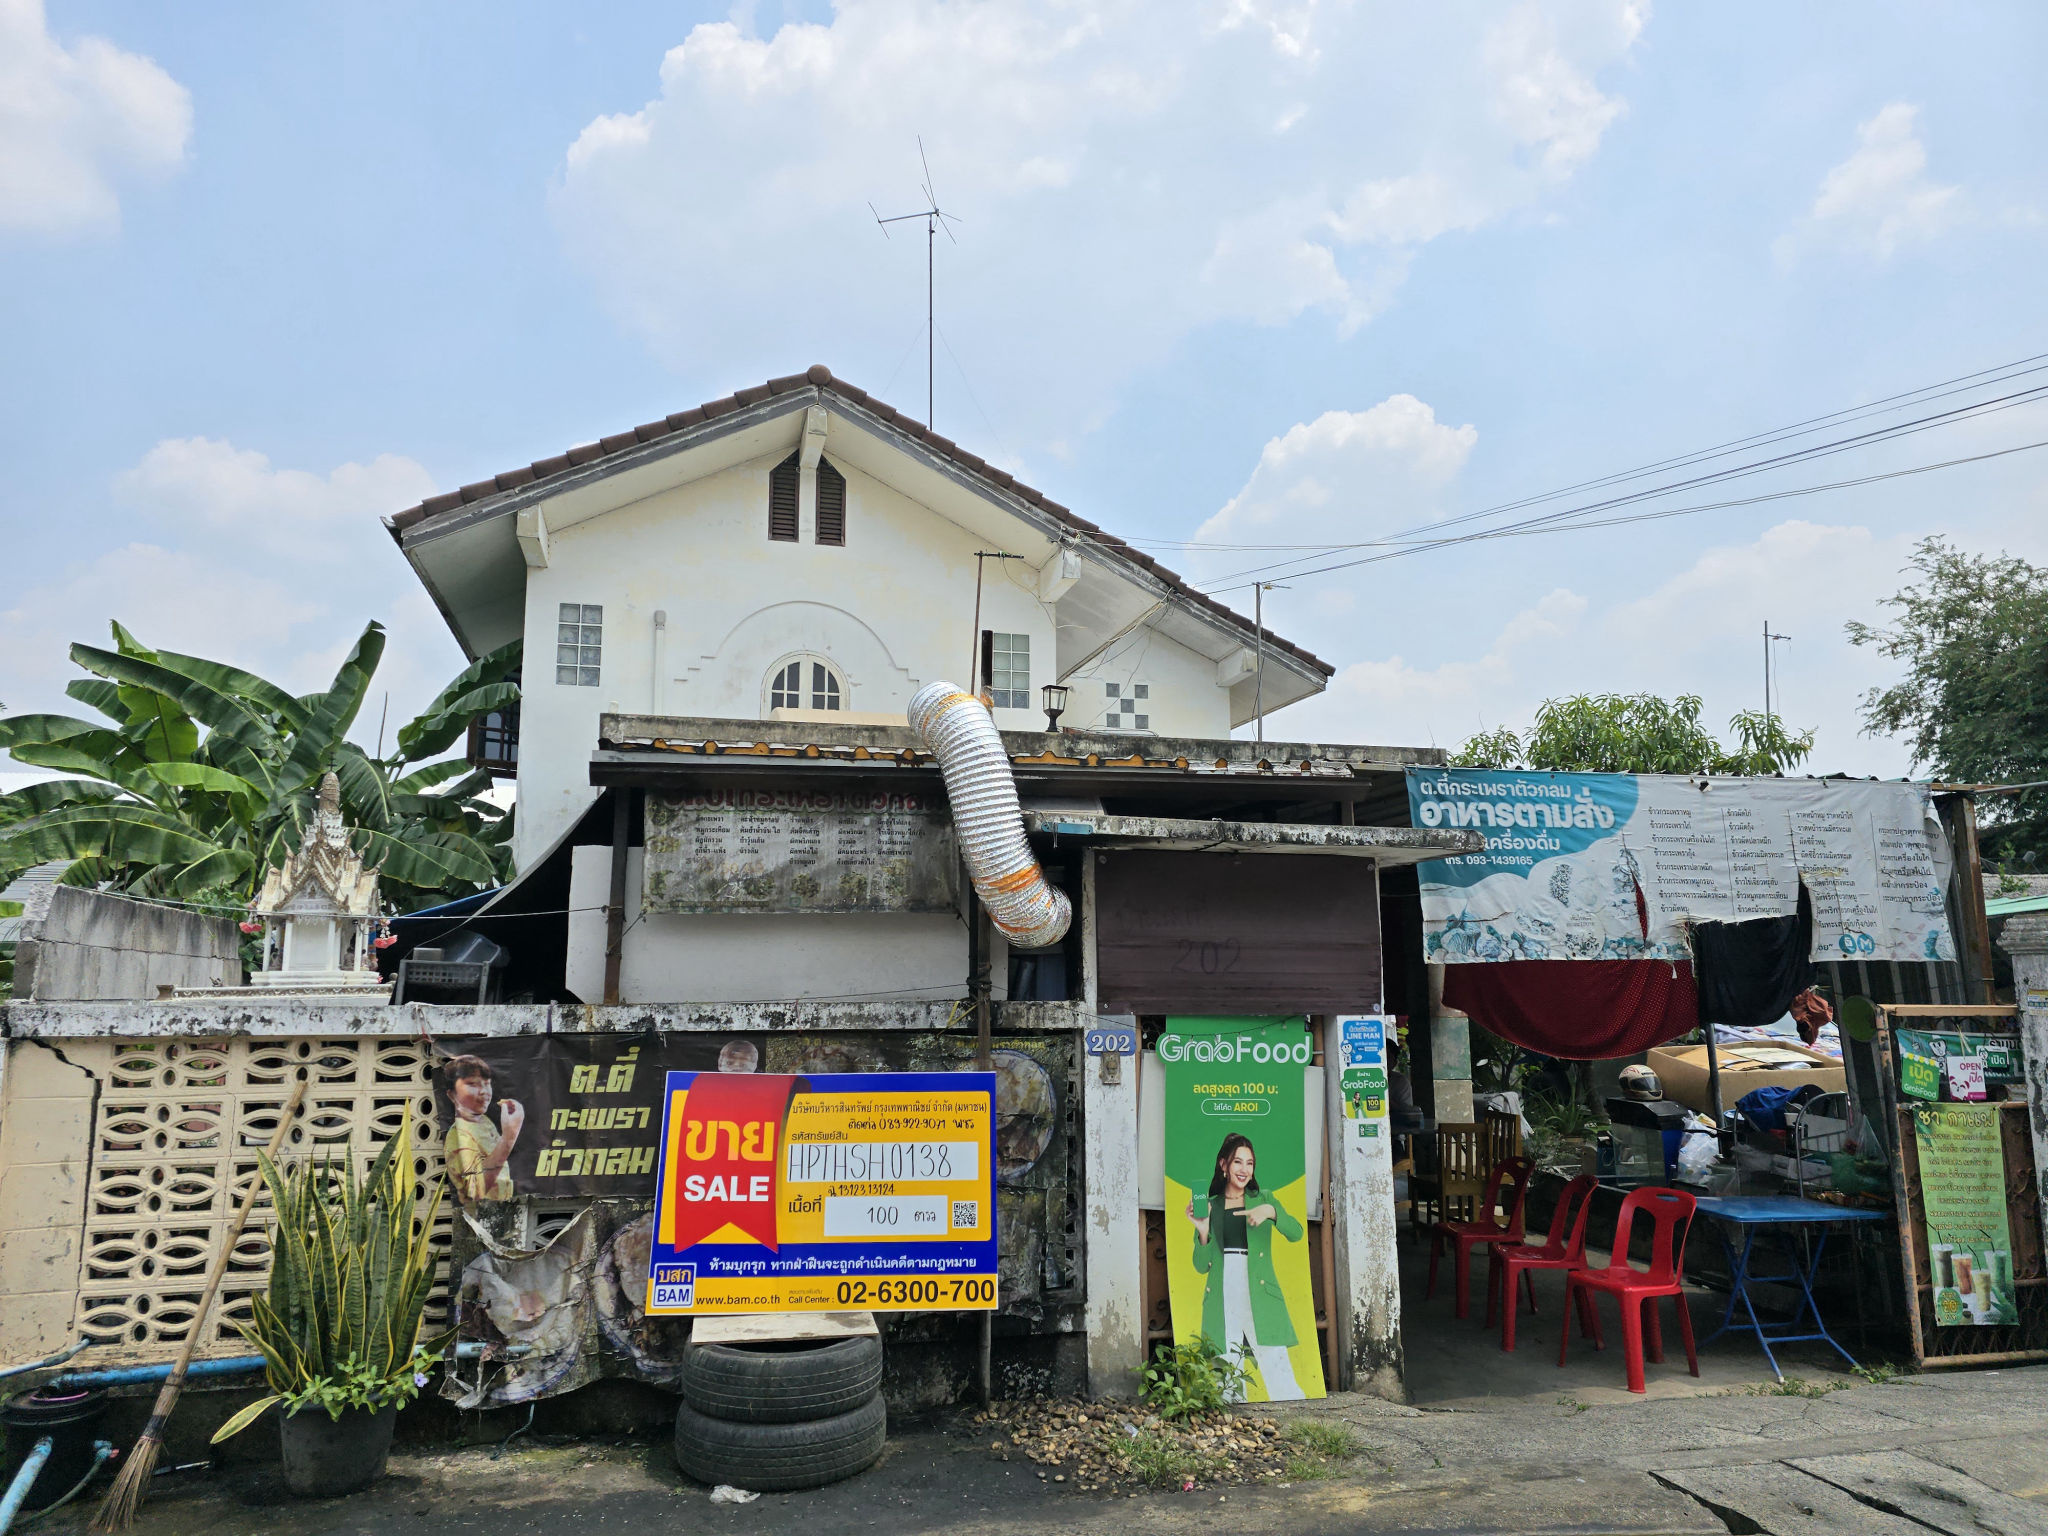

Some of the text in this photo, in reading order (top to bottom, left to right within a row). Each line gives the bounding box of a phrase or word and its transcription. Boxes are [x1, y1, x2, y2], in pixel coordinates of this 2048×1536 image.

[1420, 786, 1615, 829] อาหารตามสั่ง
[1466, 855, 1533, 865] 093-1439165
[1091, 1034, 1130, 1052] 202
[1346, 1032, 1362, 1040] LINE
[1159, 1032, 1311, 1064] GrabFood
[1908, 1062, 1934, 1083] เปิด
[1959, 1062, 1982, 1071] OPEN
[1342, 1079, 1386, 1089] GrabFood
[1968, 1071, 1983, 1083] เปิด
[1193, 1083, 1240, 1097] ลดสูงสุด
[1242, 1082, 1265, 1094] 100
[1903, 1083, 1937, 1099] GrabFood
[792, 1100, 987, 1116] บริษัทบริหารสินทรัพย์ กรุงเทพพาณิชย์ จำกัด (มหาชน)
[1233, 1102, 1259, 1112] AROI
[551, 1106, 651, 1131] กะเพรา
[1918, 1109, 1995, 1128] ชา กาแฟ
[685, 1120, 775, 1161] ขาย
[791, 1130, 848, 1141] รหัสทรัพย์สิน
[535, 1139, 656, 1177] ตัวกลม
[788, 1143, 952, 1182] HPTHSH0138
[684, 1175, 770, 1202] SALE
[788, 1194, 822, 1213] เนื้อที่
[866, 1206, 899, 1225] 100
[658, 1267, 692, 1283] บสก
[709, 1257, 766, 1276] ห้ามบุกรุก
[657, 1288, 692, 1304] BAM
[695, 1293, 780, 1305] www.bam.co.th
[788, 1295, 803, 1304] Call
[804, 1295, 830, 1304] Center
[837, 1279, 995, 1304] 02-6300-700
